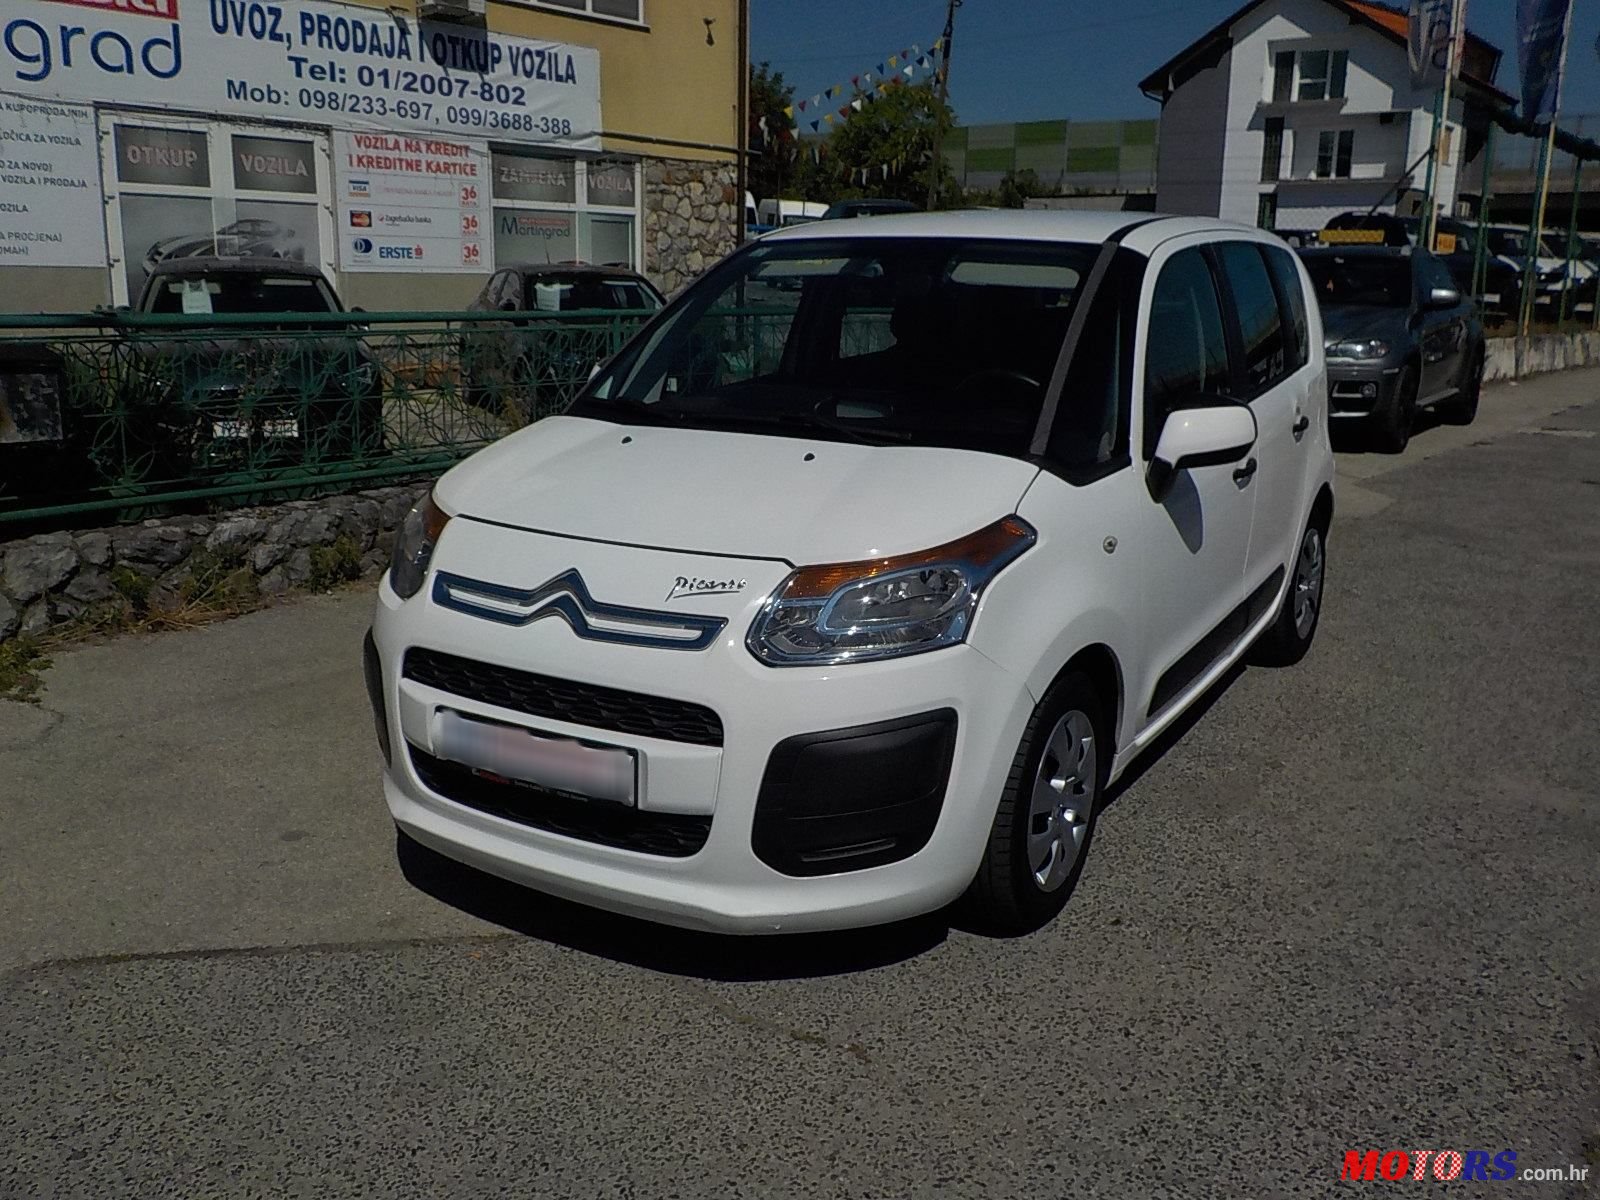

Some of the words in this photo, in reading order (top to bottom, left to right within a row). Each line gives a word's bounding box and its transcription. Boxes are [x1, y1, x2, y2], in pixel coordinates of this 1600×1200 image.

[4, 19, 182, 82] grad
[210, 0, 292, 51] UVOZ,
[300, 11, 412, 61] PRODAJA
[418, 30, 425, 62] I
[432, 33, 502, 75] OTKUP
[508, 45, 577, 84] VOZILA
[287, 55, 347, 84] Tel:
[357, 65, 527, 107] 01/2007-802
[5, 103, 89, 119] KUPOPRODAJNIH
[226, 79, 290, 106] Mob:
[299, 88, 440, 125] 098/233-697,
[447, 105, 572, 136] 099/3688-388
[33, 133, 47, 144] ZA
[47, 135, 81, 146] VOZILA
[354, 134, 402, 152] VOZILA
[404, 139, 422, 154] NA
[425, 140, 471, 157] KREDIT
[7, 160, 21, 170] ZA
[127, 143, 198, 168] OTKUP
[239, 153, 309, 177] VOZILA
[348, 153, 353, 168] I
[356, 154, 422, 172] KREDITNE
[425, 159, 478, 177] KARTICE
[1, 175, 36, 185] VOZILA
[43, 177, 87, 188] PRODAJA
[588, 173, 634, 192] VOZILA
[461, 186, 477, 201] 36
[462, 215, 478, 230] 36
[379, 246, 413, 259] ERSTE
[463, 243, 479, 259] 36
